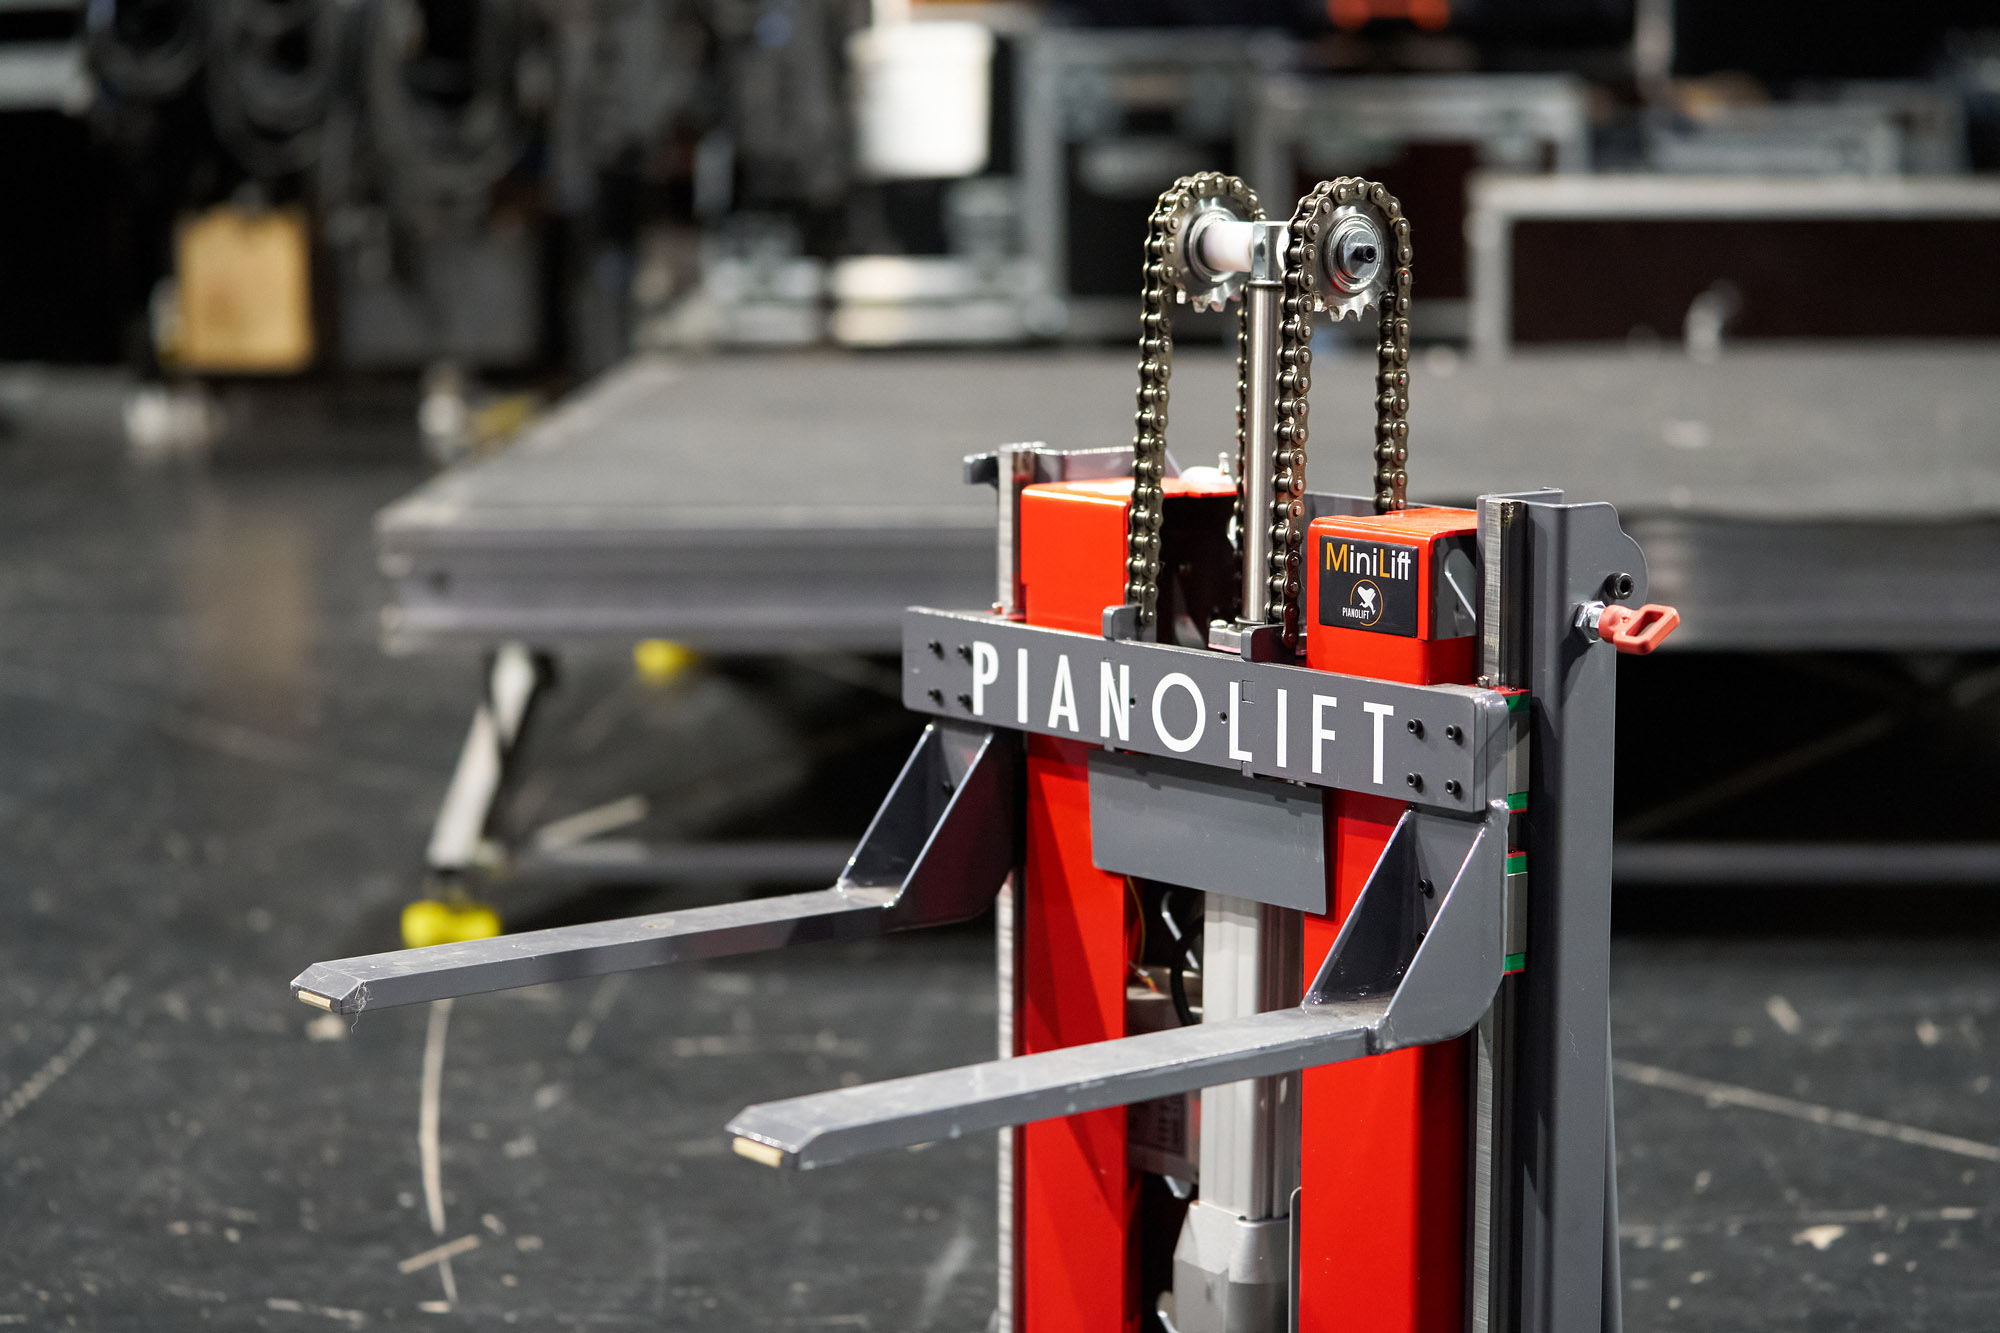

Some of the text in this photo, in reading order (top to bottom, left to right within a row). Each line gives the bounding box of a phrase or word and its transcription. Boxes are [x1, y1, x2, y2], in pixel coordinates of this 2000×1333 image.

[1326, 542, 1411, 580] MiniLift
[1342, 607, 1370, 620] PIANOLIFT
[972, 641, 1394, 784] PIANOLIFT
